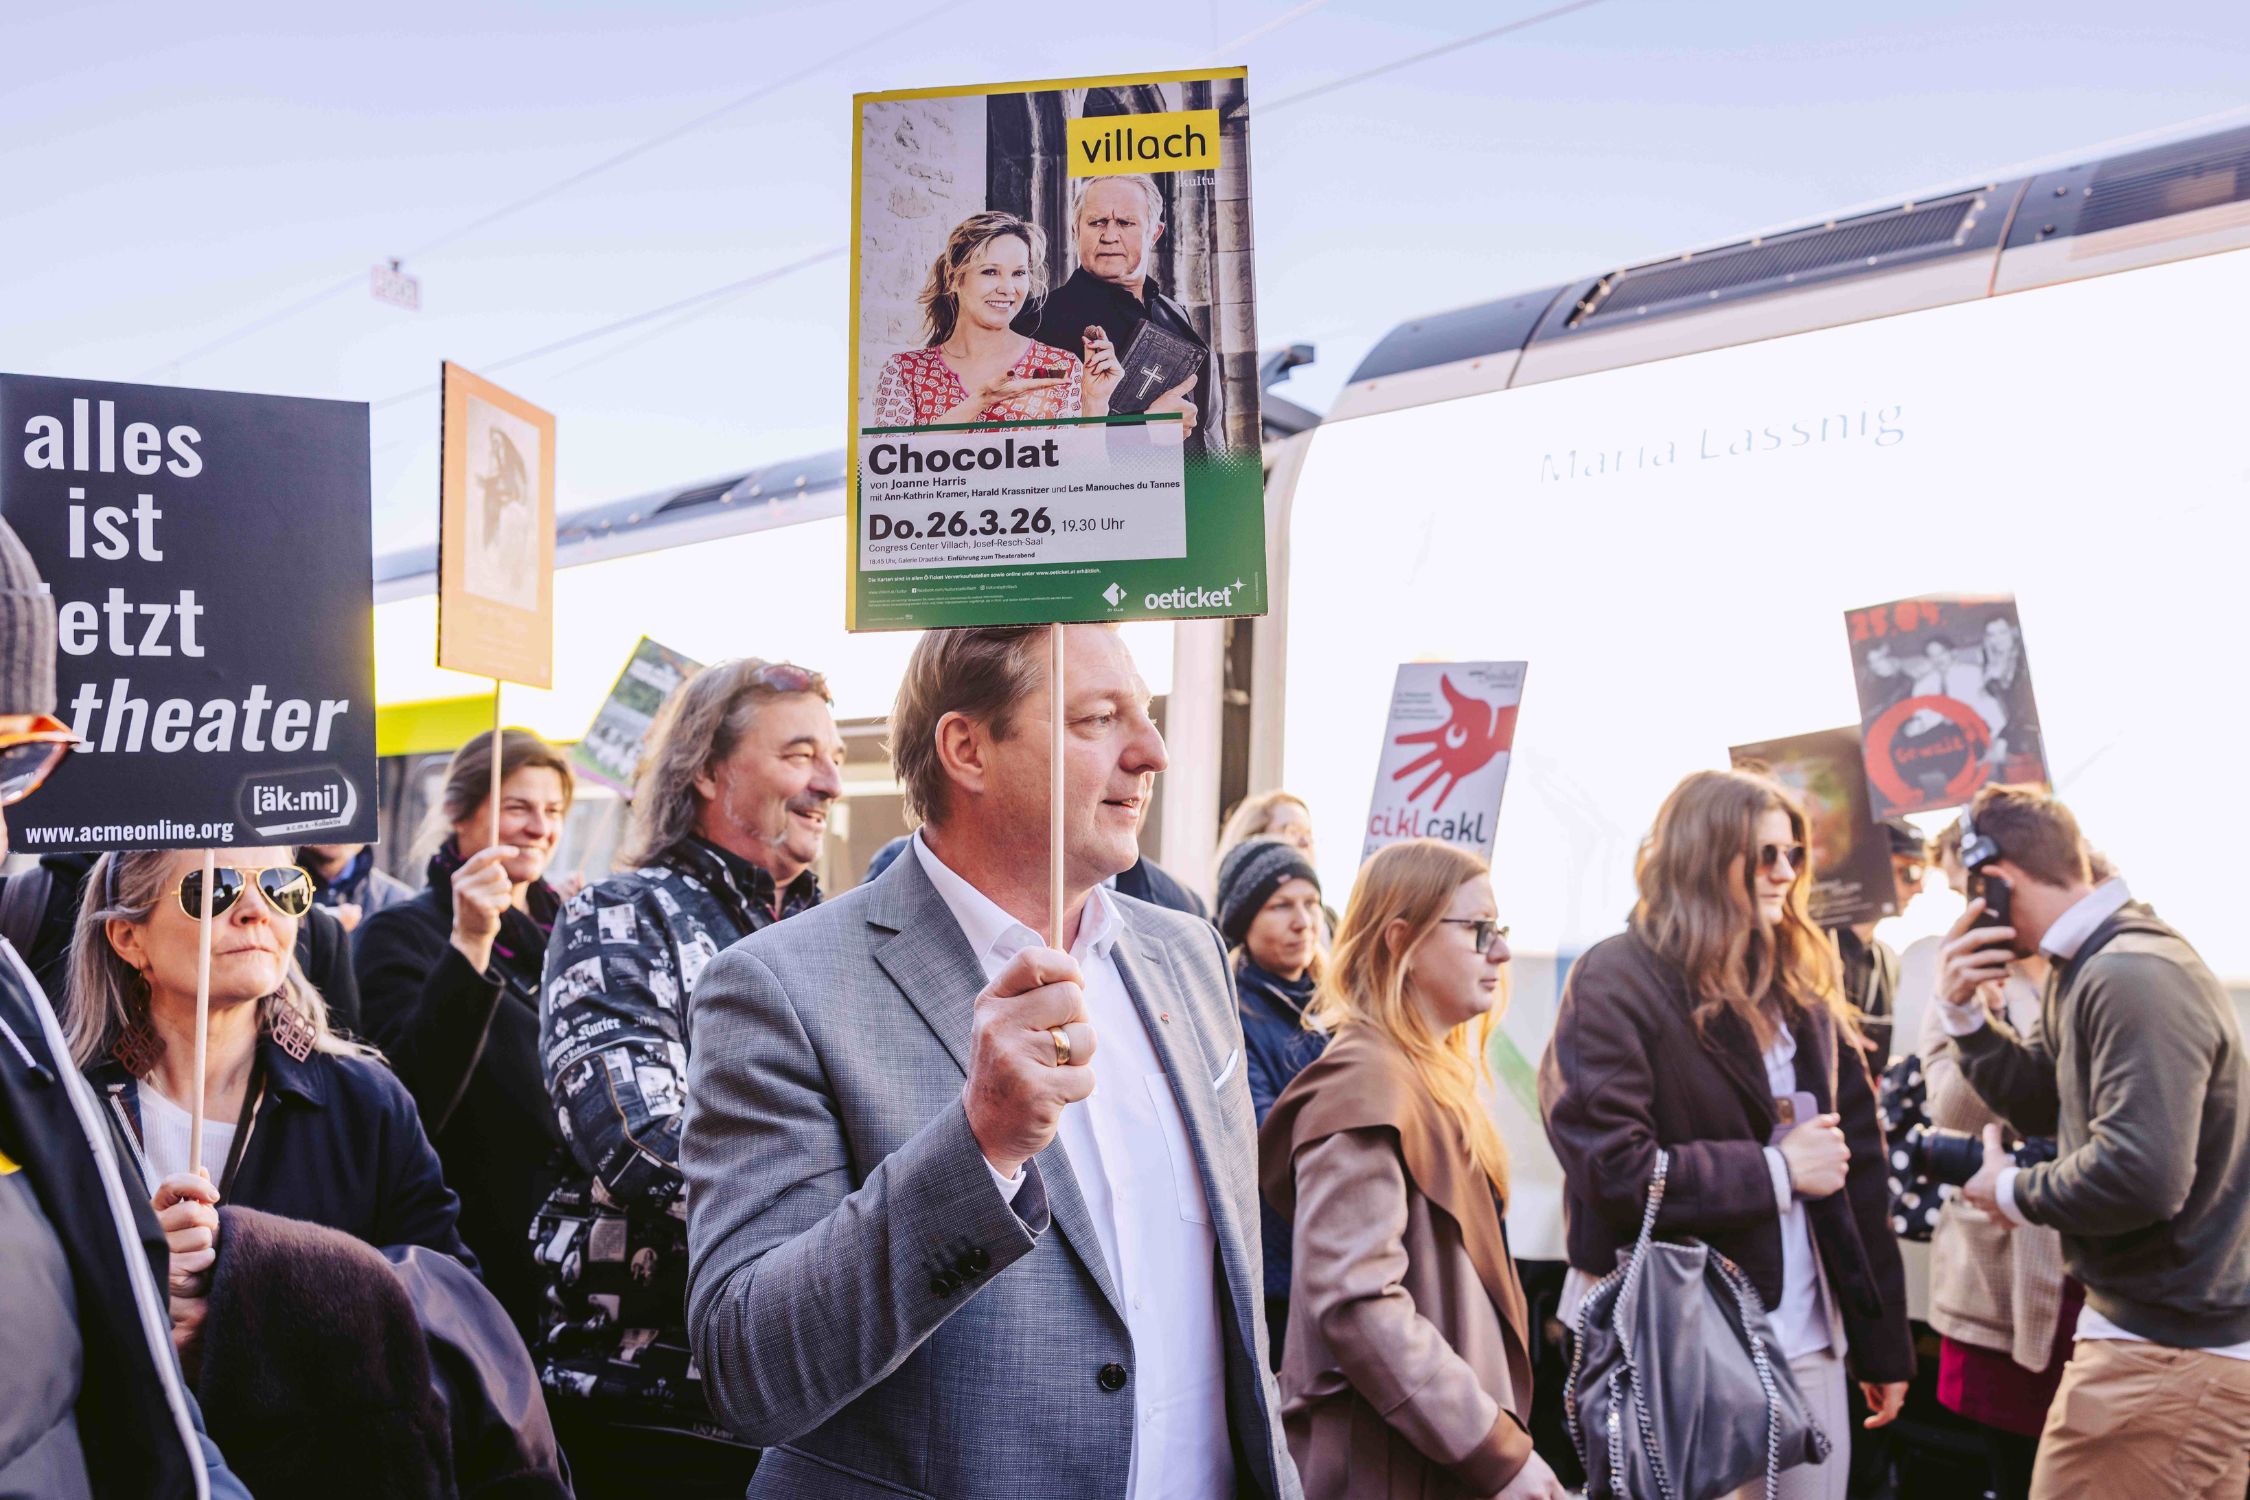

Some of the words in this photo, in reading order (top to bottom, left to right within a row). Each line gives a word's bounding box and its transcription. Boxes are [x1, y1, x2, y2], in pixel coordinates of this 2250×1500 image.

[1082, 124, 1206, 163] villach
[23, 398, 203, 478] alles
[1699, 402, 1904, 460] Lassnig
[868, 438, 1059, 475] Chocolat
[870, 481, 888, 490] von
[891, 479, 930, 490] Joanne
[932, 476, 967, 487] Harris
[870, 493, 882, 502] mit
[884, 491, 934, 501] Ann-Kathrin
[936, 489, 970, 499] Kramer,
[971, 488, 999, 497] Harald
[1001, 485, 1049, 496] Krassnitzer
[1051, 485, 1067, 493] und
[1068, 484, 1084, 493] Les
[1085, 482, 1135, 492] Manouches
[1136, 481, 1148, 489] du
[1149, 480, 1181, 489] Tannes
[69, 487, 163, 562] ist
[1061, 518, 1097, 532] 19.30
[1101, 517, 1125, 531] Uhr
[868, 543, 908, 553] Congress
[910, 542, 939, 551] Center
[940, 540, 971, 550] Villach,
[973, 537, 1043, 548] Josef-Resch-Saal
[947, 554, 980, 562] Einführung
[1144, 586, 1233, 610] oeticket
[37, 582, 205, 658] etzt
[70, 678, 349, 754] theater
[253, 784, 339, 815] [äk:mi]
[26, 820, 235, 842] www.acmeonline.org
